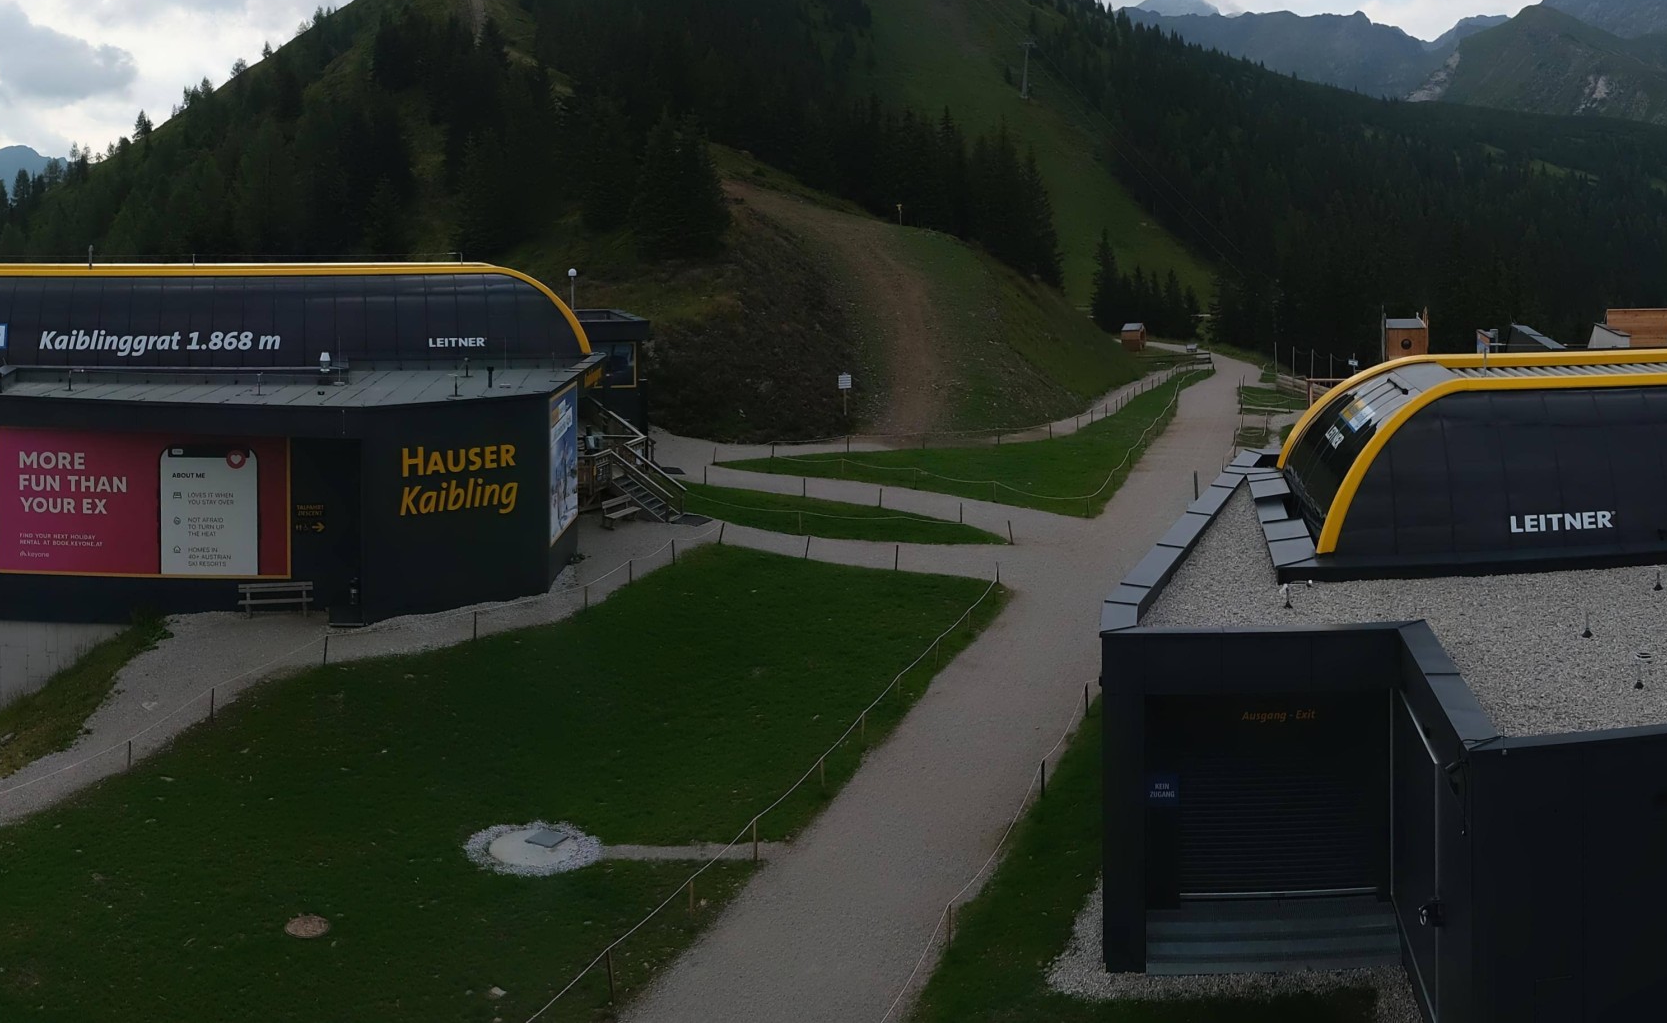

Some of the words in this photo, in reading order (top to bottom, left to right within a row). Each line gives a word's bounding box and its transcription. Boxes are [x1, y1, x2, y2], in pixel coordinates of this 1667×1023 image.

[39, 330, 181, 357] Kaiblinggrat
[186, 331, 253, 350] 1.868
[258, 335, 281, 350] m
[428, 337, 486, 347] LEITNER
[19, 451, 85, 470] MORE
[402, 444, 516, 477] HAUSER
[19, 474, 60, 492] FUN
[67, 475, 127, 493] THAN
[20, 497, 76, 514] YOUR
[82, 498, 108, 515] EX
[400, 478, 518, 516] Kaibling
[1510, 511, 1613, 533] LEITNER
[1241, 711, 1287, 723] Ausgang
[1295, 709, 1316, 719] Exit
